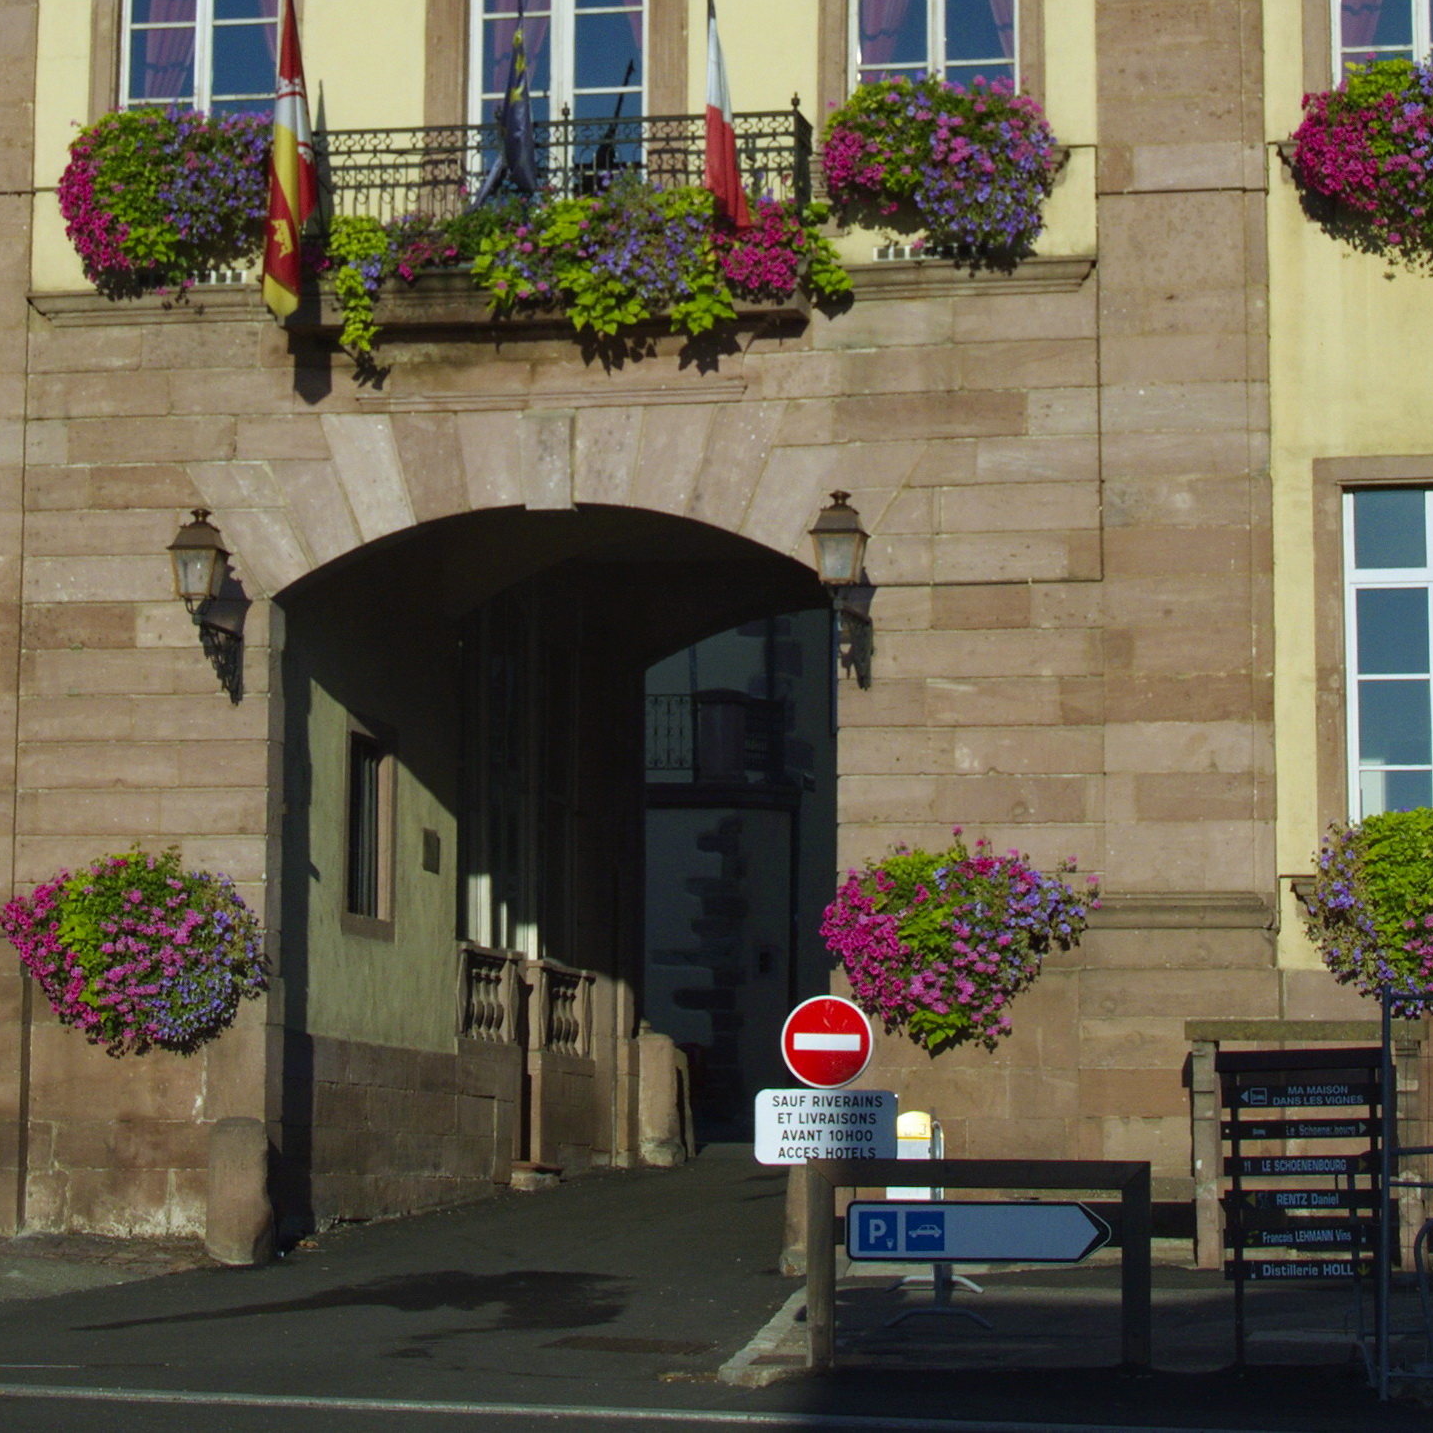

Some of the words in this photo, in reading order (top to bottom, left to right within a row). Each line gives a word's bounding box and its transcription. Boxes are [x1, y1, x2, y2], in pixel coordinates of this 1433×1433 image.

[1288, 1086, 1304, 1095] MA
[1307, 1085, 1348, 1094] MAISON
[772, 1095, 806, 1107] SAUF
[812, 1095, 883, 1108] RIVERAINS
[1273, 1096, 1301, 1106] DANS
[1303, 1096, 1322, 1105] LES
[1325, 1095, 1364, 1105] VIGNES
[778, 1113, 793, 1124] ET
[798, 1113, 876, 1125] LIVRAISONS
[781, 1130, 822, 1141] AVANT
[829, 1130, 873, 1142] 10H00
[778, 1147, 819, 1159] ACCES
[826, 1147, 876, 1159] HOTELS
[1262, 1160, 1271, 1172] LE
[1274, 1159, 1347, 1172] SCHOENENBOURG
[1276, 1193, 1308, 1205] RENTZ
[1311, 1192, 1339, 1205] Daniel
[869, 1219, 887, 1244] P
[1295, 1230, 1334, 1243] LEHMANN
[1335, 1230, 1352, 1241] Vins
[1262, 1264, 1318, 1276] Distillerie
[1323, 1264, 1354, 1276] HOLL
